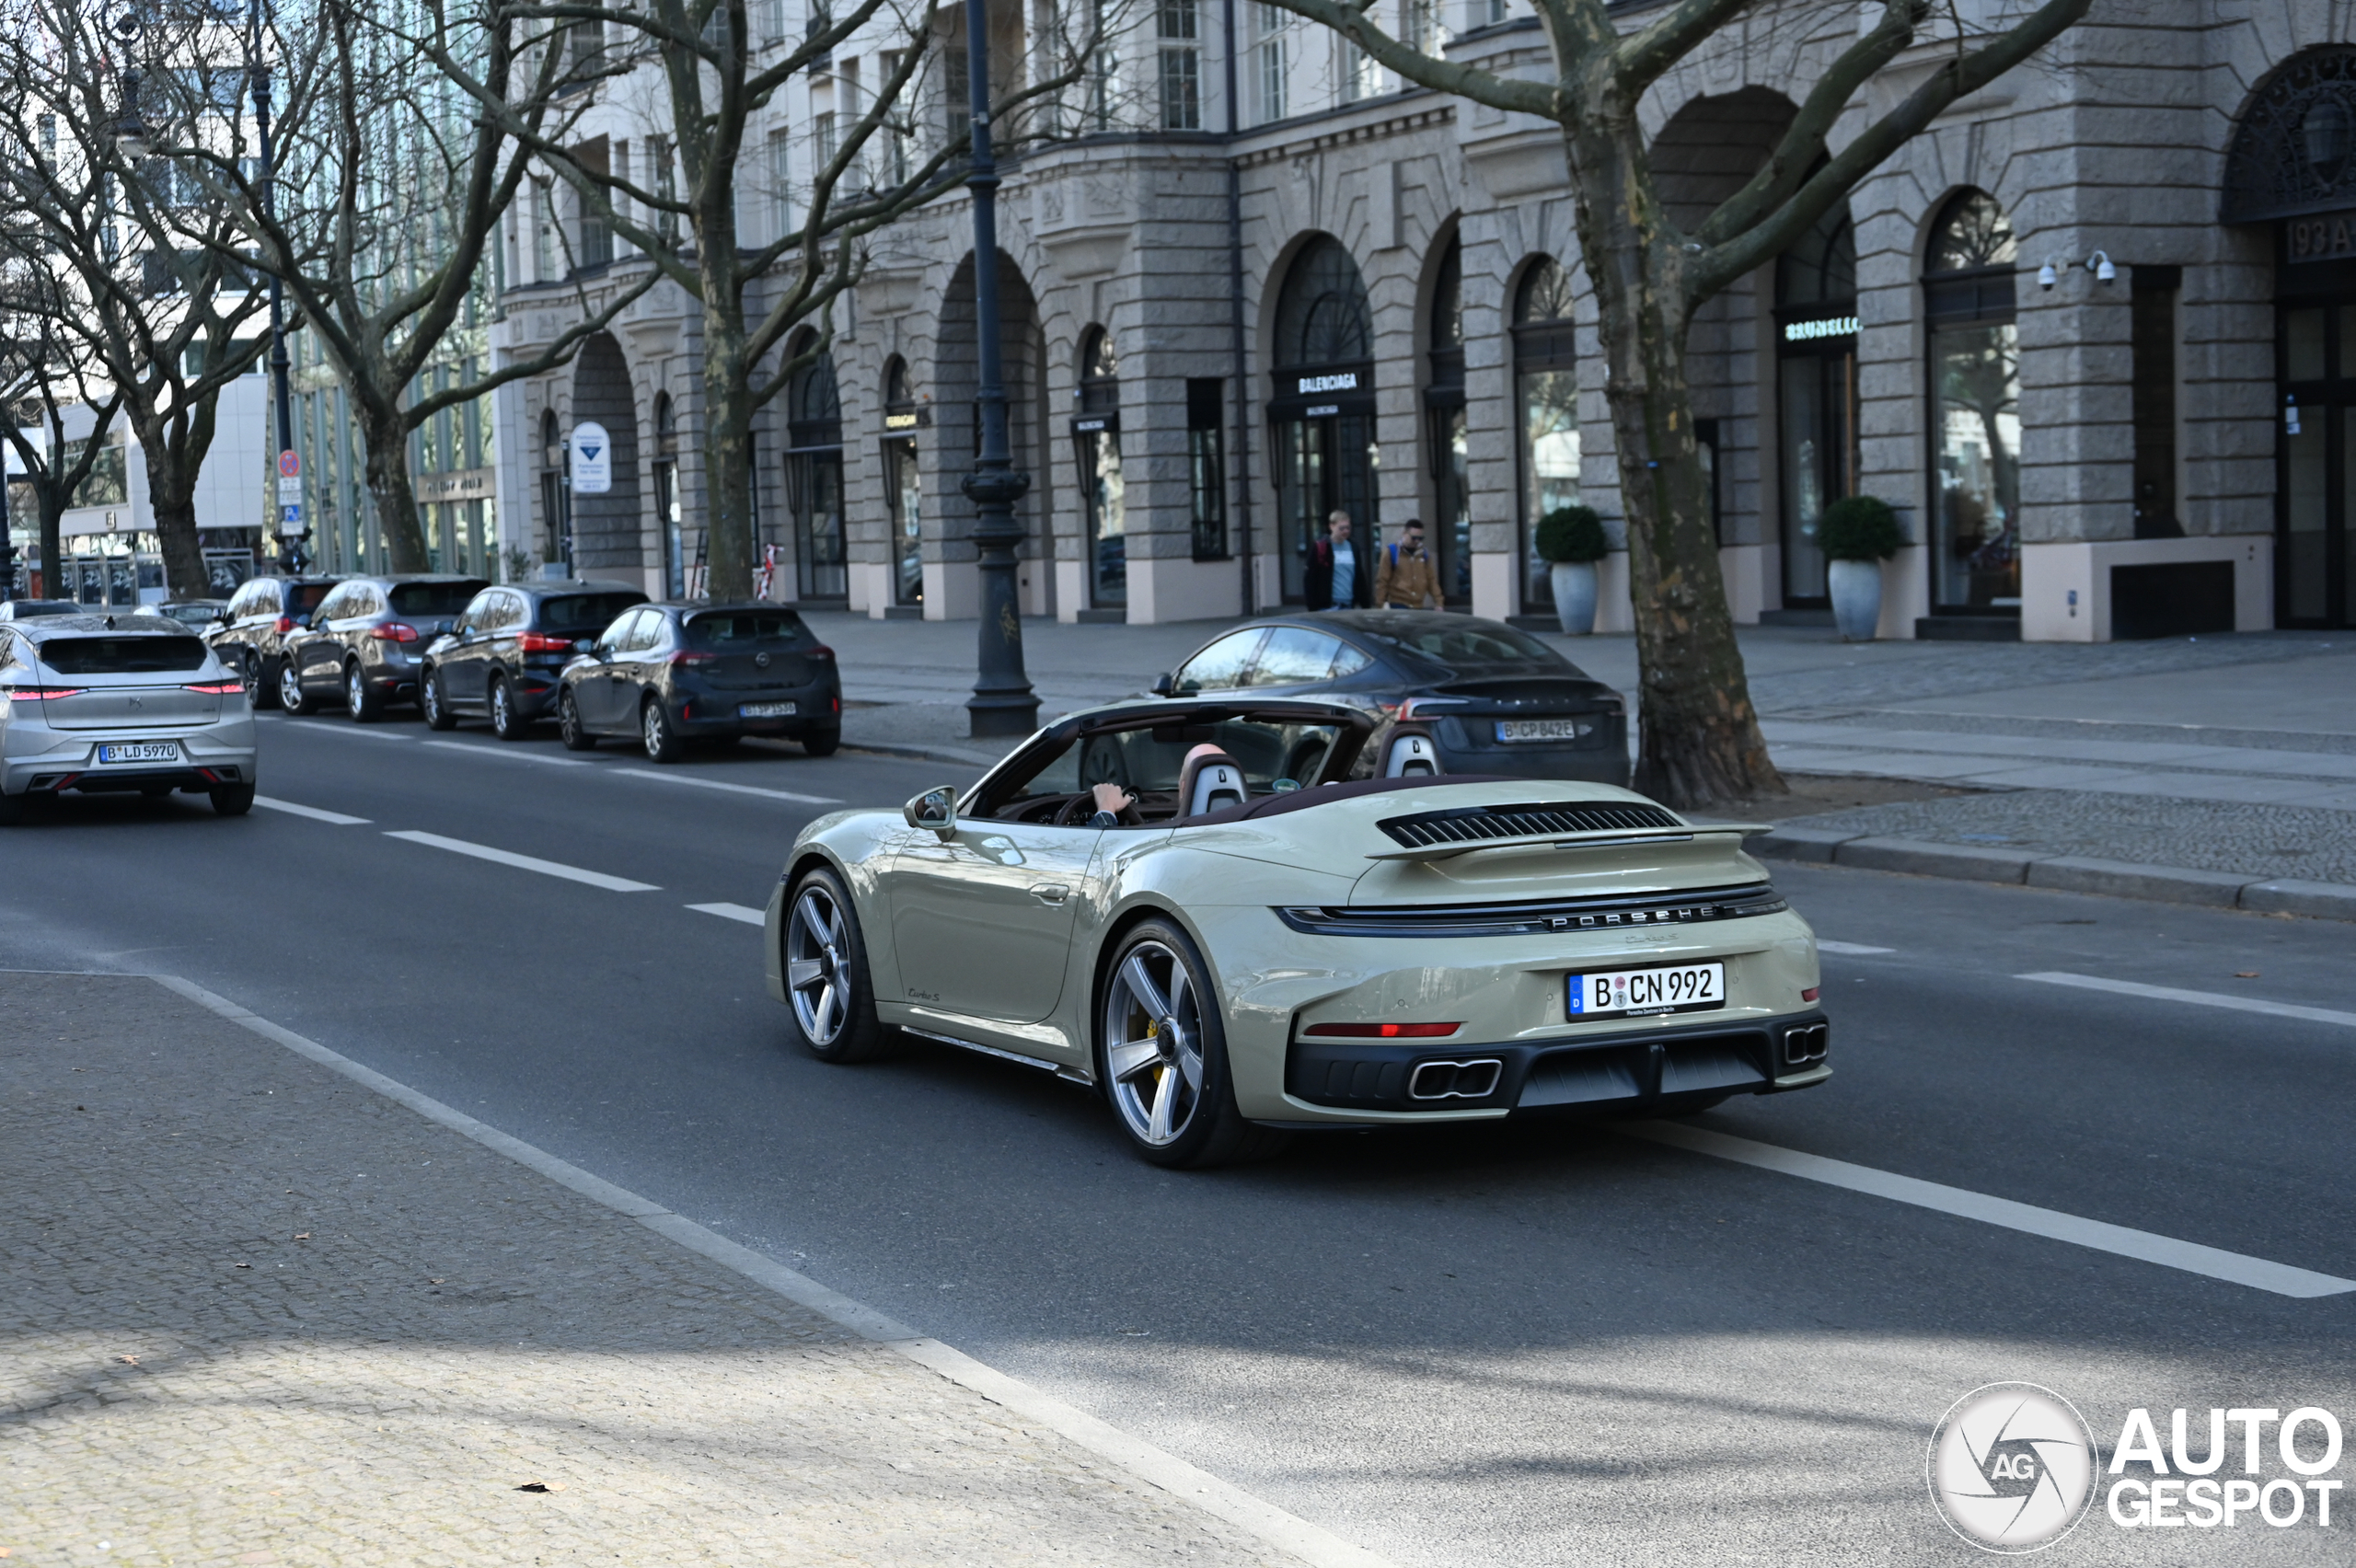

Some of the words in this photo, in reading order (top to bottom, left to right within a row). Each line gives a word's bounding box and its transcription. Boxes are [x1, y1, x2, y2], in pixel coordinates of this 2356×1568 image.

[1299, 373, 1357, 394] BALENCIAGA
[1504, 723, 1514, 737] B
[1520, 722, 1537, 737] CP
[1540, 721, 1573, 736] 842E
[108, 747, 116, 759] B
[124, 746, 141, 758] LD
[144, 744, 175, 757] 5970
[1552, 906, 1715, 928] PORSCHE
[1596, 978, 1611, 1007] B
[1630, 973, 1663, 1004] CN
[1669, 969, 1713, 1000] 992
[1573, 998, 1580, 1008] D
